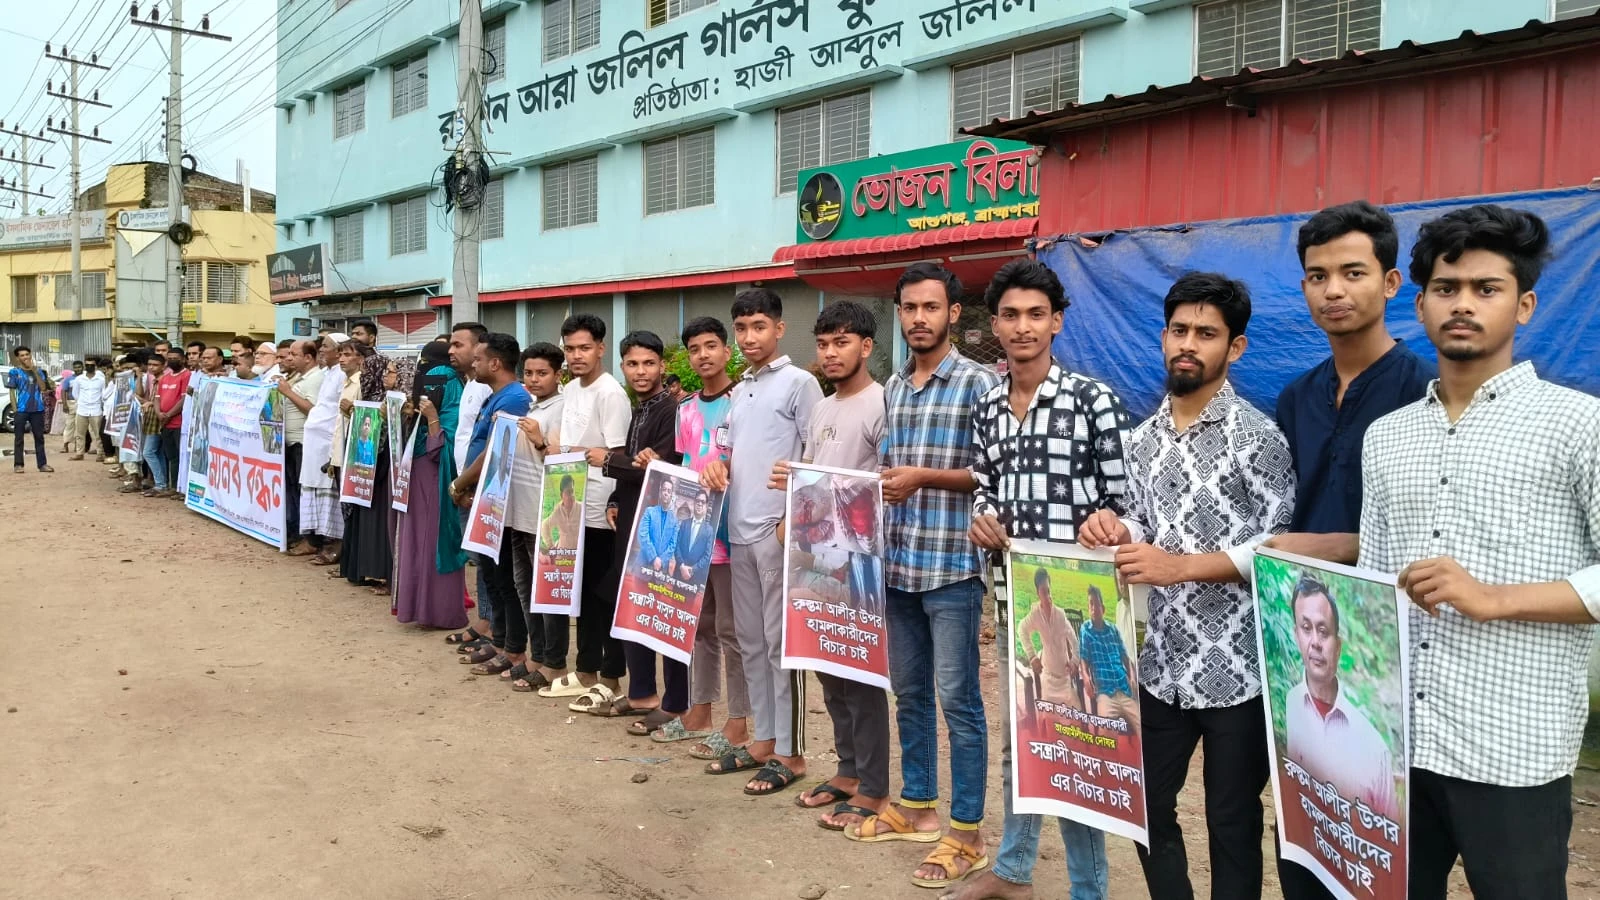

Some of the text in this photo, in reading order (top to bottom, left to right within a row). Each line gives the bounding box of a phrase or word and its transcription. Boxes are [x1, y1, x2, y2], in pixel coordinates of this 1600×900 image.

[516, 65, 578, 114] আরা
[586, 29, 689, 95] জলিল
[734, 45, 795, 90] হাজী
[808, 21, 904, 69] আব্দুল
[852, 163, 957, 217] ভোজন
[208, 446, 241, 498] মানব
[636, 614, 686, 642] এর বিচার চাই
[657, 600, 675, 619] মাসুদ
[677, 609, 697, 626] আলম
[792, 598, 882, 629] রুস্তম আলীর উপর
[805, 618, 879, 646] হামলাকারীদের
[819, 635, 869, 663] বিচার চাই
[1089, 714, 1128, 732] হামলাকারী
[1029, 740, 1141, 787] সন্ত্রাসী মাসুদ আলম
[1050, 773, 1132, 813] এর বিচার চাই
[1282, 757, 1400, 845] রুস্তম আলীর উপর
[1299, 793, 1393, 872] হামলাকারীদের
[1313, 827, 1374, 896] বিচার চাই
